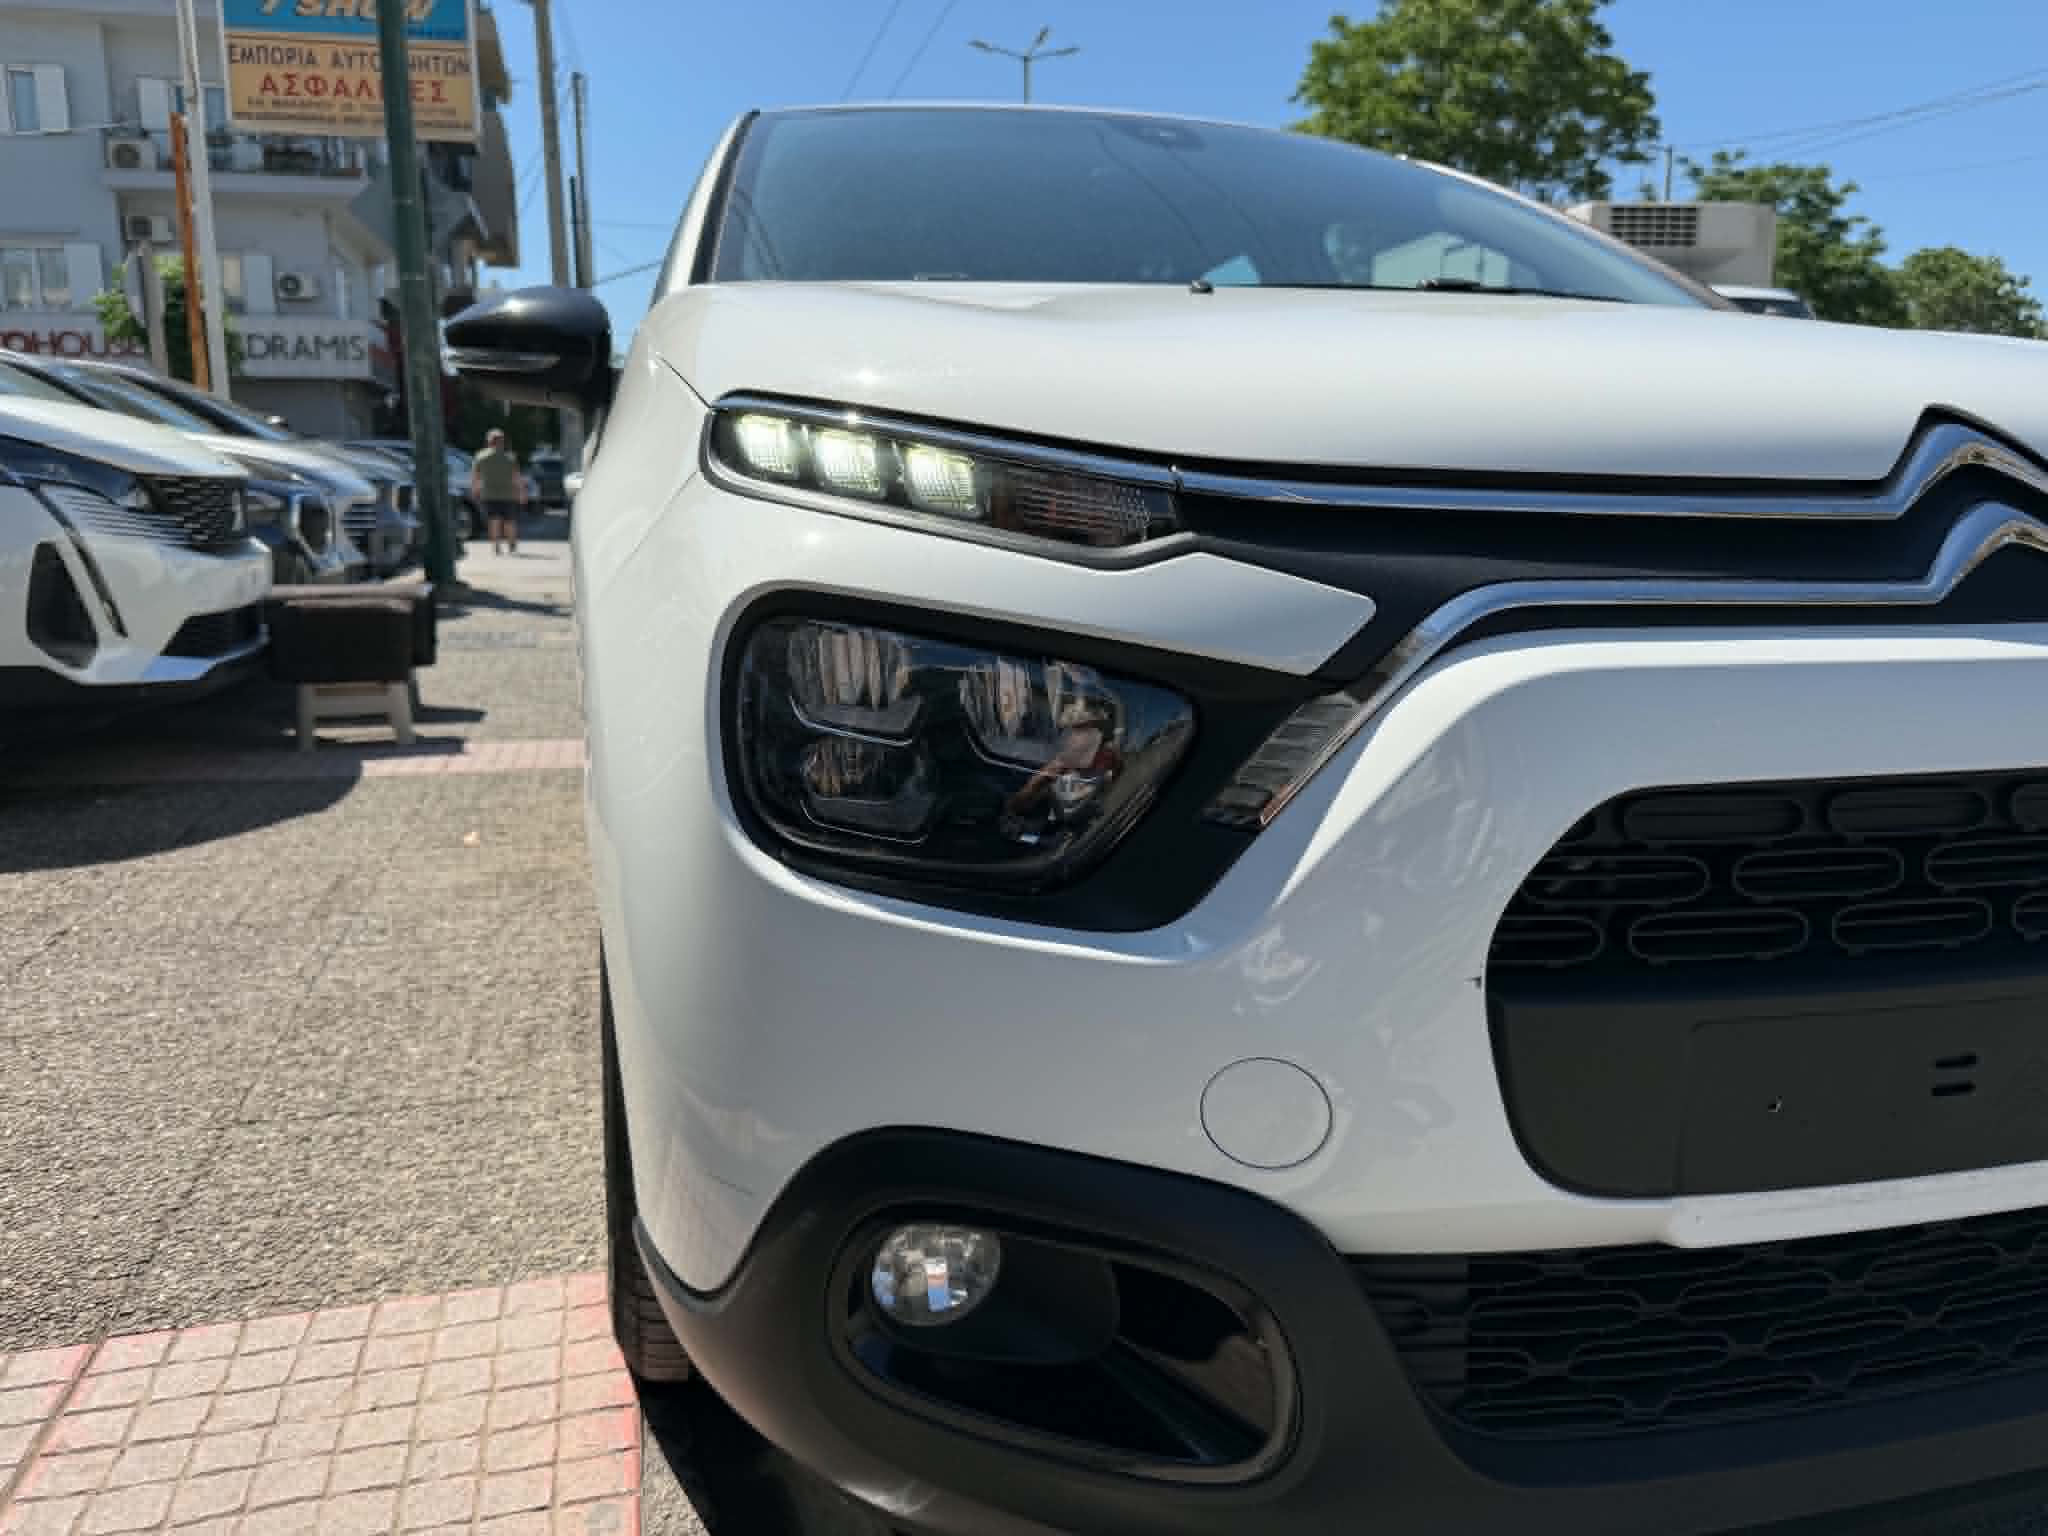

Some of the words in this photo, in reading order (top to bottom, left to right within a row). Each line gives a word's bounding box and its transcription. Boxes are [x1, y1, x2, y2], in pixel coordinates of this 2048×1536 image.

[227, 44, 320, 65] ΕΜΠΟΡΙΑ
[259, 71, 450, 104] ΑΣΦΑΛΕΣ
[246, 332, 367, 361] DRAMIS
